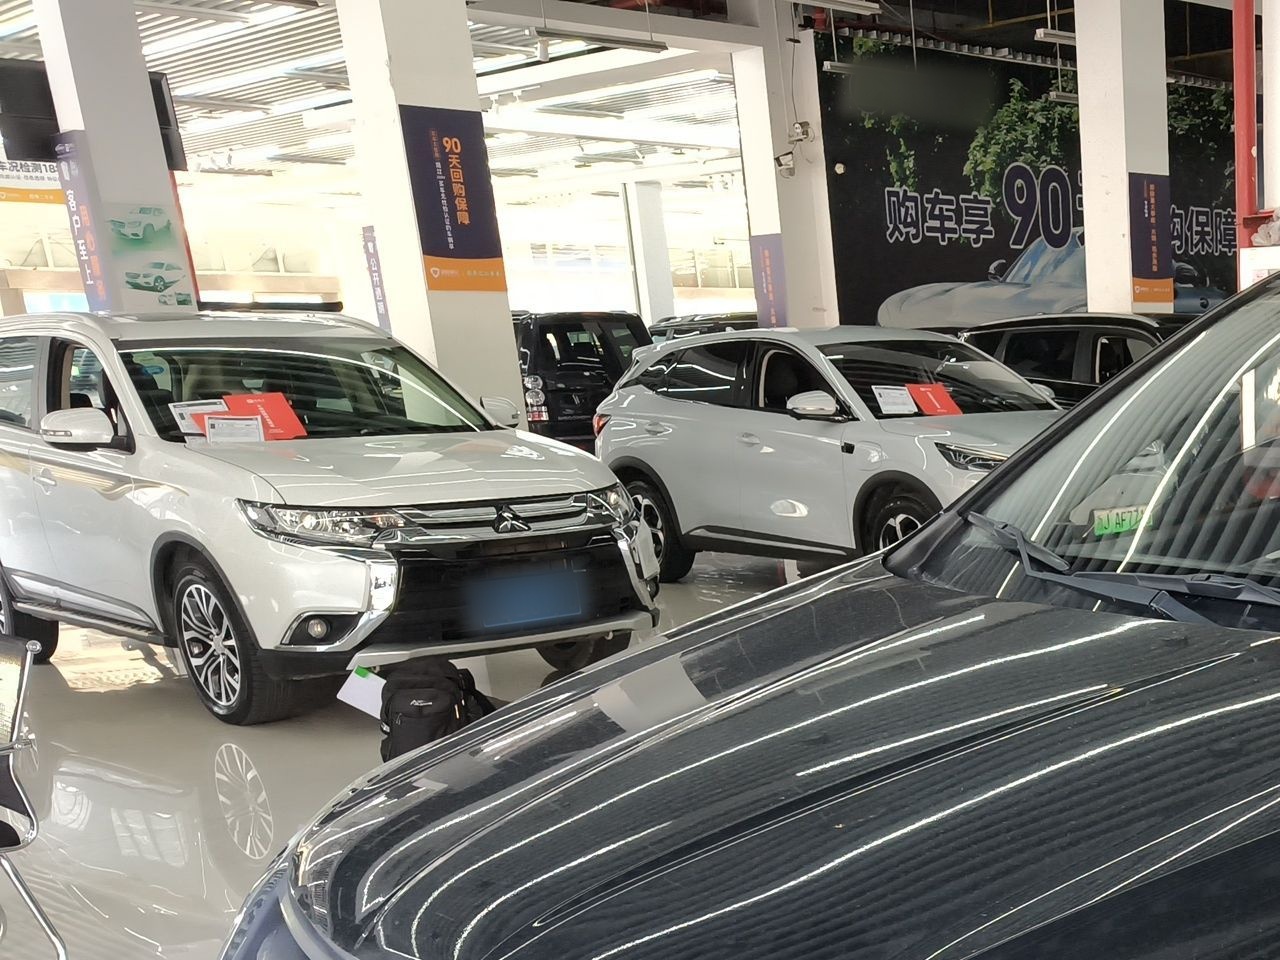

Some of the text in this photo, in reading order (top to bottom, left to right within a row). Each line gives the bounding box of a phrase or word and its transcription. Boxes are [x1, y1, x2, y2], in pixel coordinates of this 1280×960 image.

[0, 160, 58, 174] 车况检测18
[885, 162, 1084, 249] 购车享90
